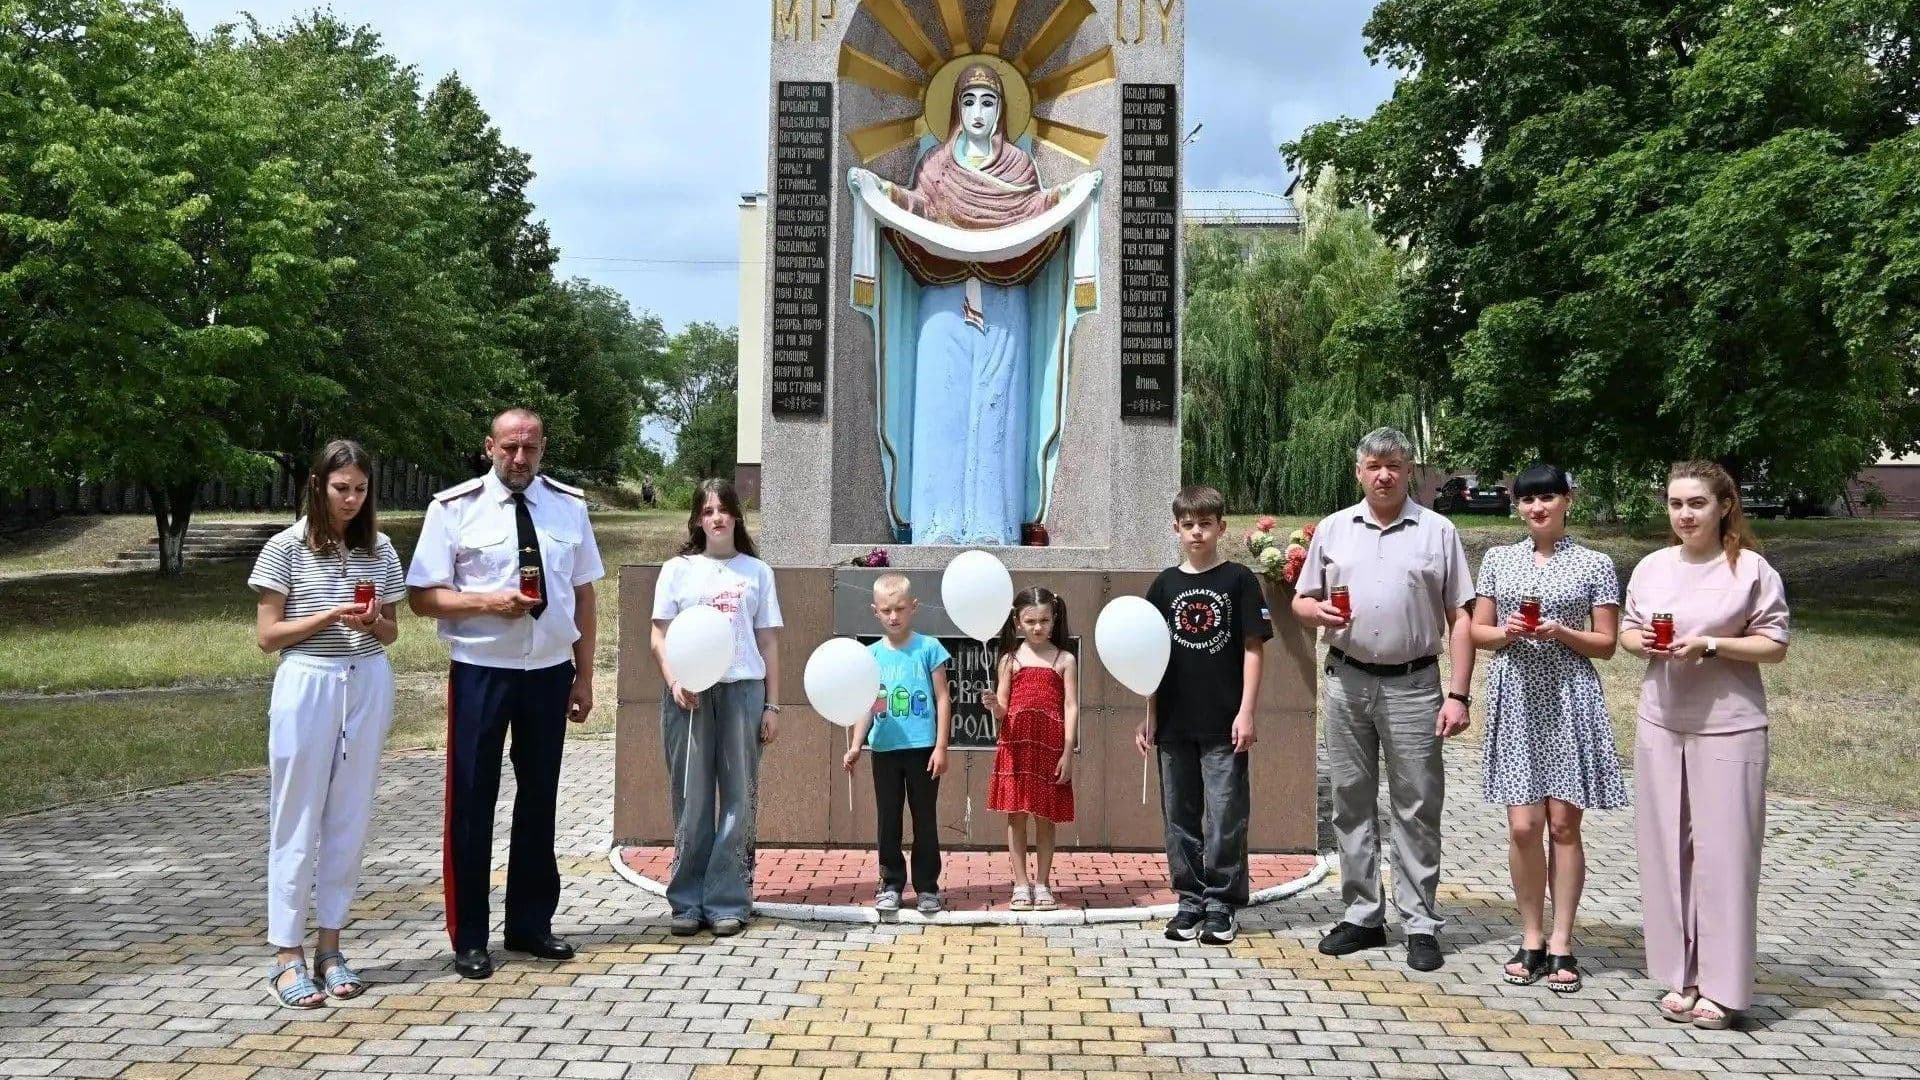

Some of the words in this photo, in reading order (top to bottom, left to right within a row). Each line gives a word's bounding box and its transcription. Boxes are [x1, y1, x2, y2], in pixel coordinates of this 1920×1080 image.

[1171, 588, 1224, 609] ИНИЦИАТИВА
[1174, 600, 1188, 630] МЕЧТА
[1209, 602, 1221, 627] ЦЕЛЬ
[1173, 630, 1224, 650] МОТИВАЦИЯ
